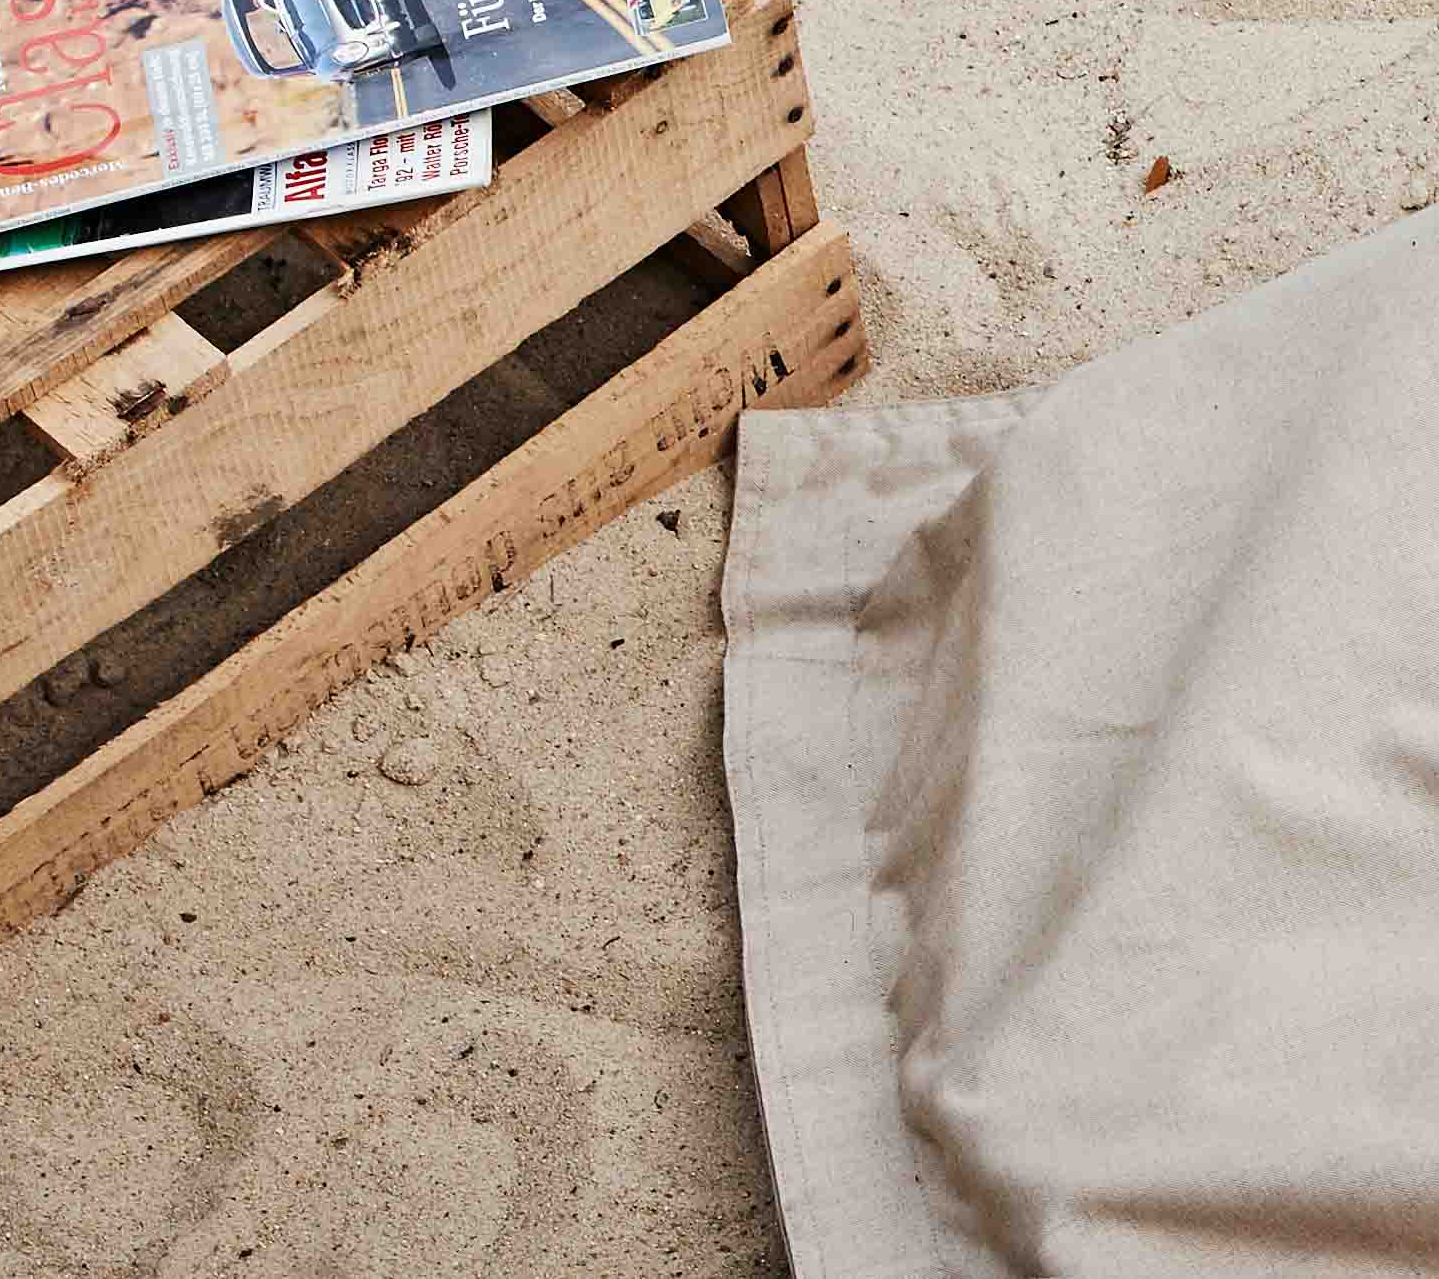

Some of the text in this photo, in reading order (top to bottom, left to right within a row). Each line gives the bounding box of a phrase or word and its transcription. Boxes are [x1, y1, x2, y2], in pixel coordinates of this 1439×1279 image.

[531, 0, 546, 22] Der
[396, 132, 415, 153] mit
[286, 150, 326, 203] Alfa
[368, 158, 387, 191] Targa
[421, 143, 442, 181] Walter
[640, 335, 798, 464] Wein
